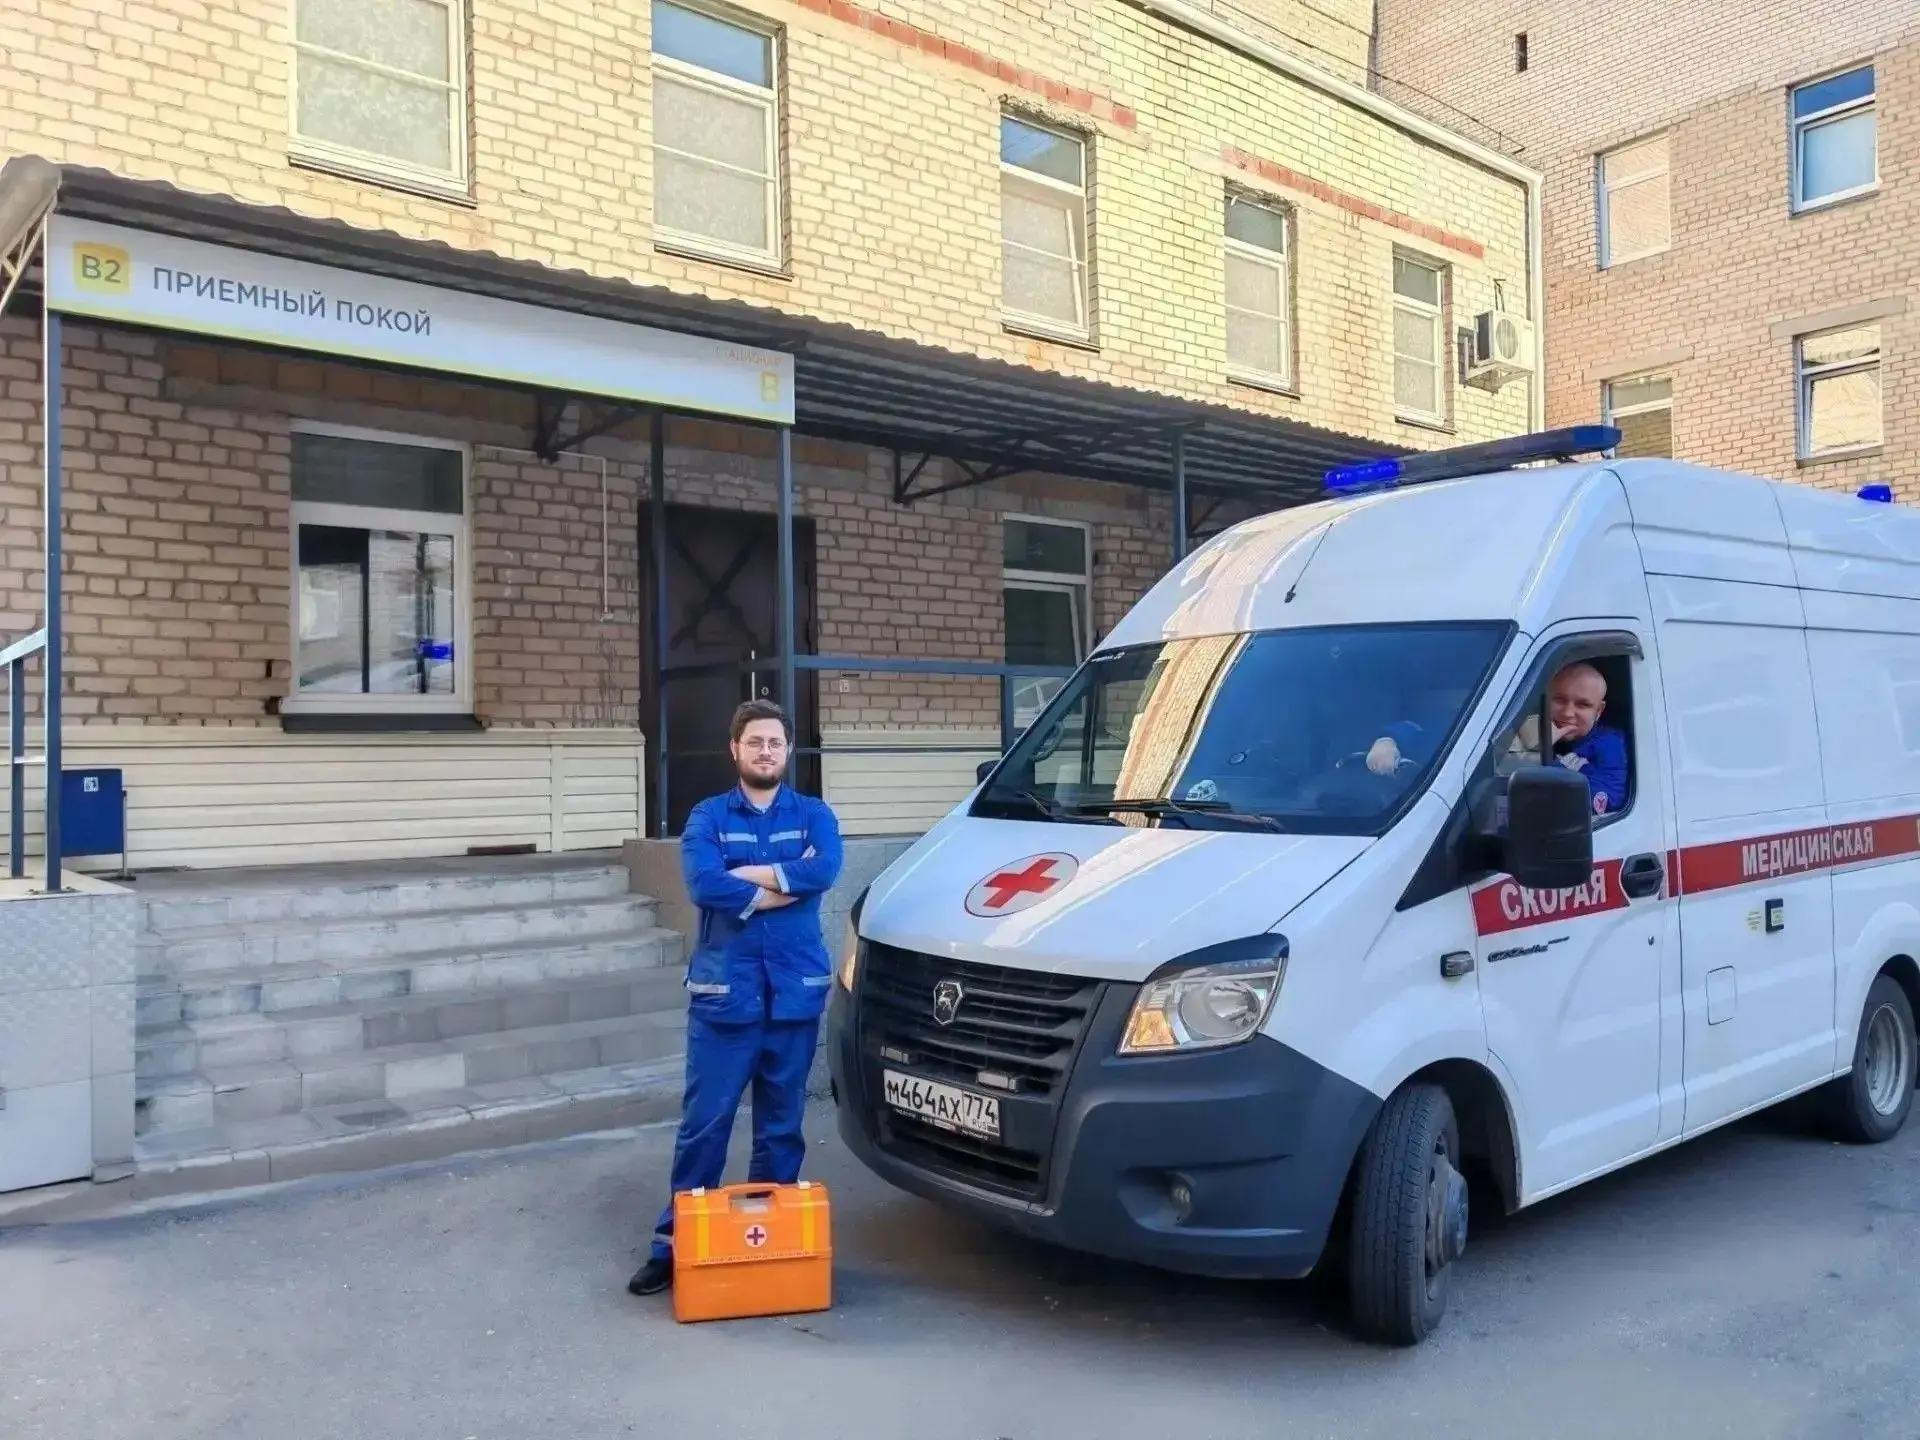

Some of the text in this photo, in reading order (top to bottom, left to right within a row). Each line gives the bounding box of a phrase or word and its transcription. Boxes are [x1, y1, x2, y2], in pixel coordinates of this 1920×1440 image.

[82, 254, 121, 284] В2
[153, 266, 432, 337] ПРИЕМНЫЙ ПОКОЙ
[1742, 826, 1874, 877] МЕДИЦИНСКАЯ
